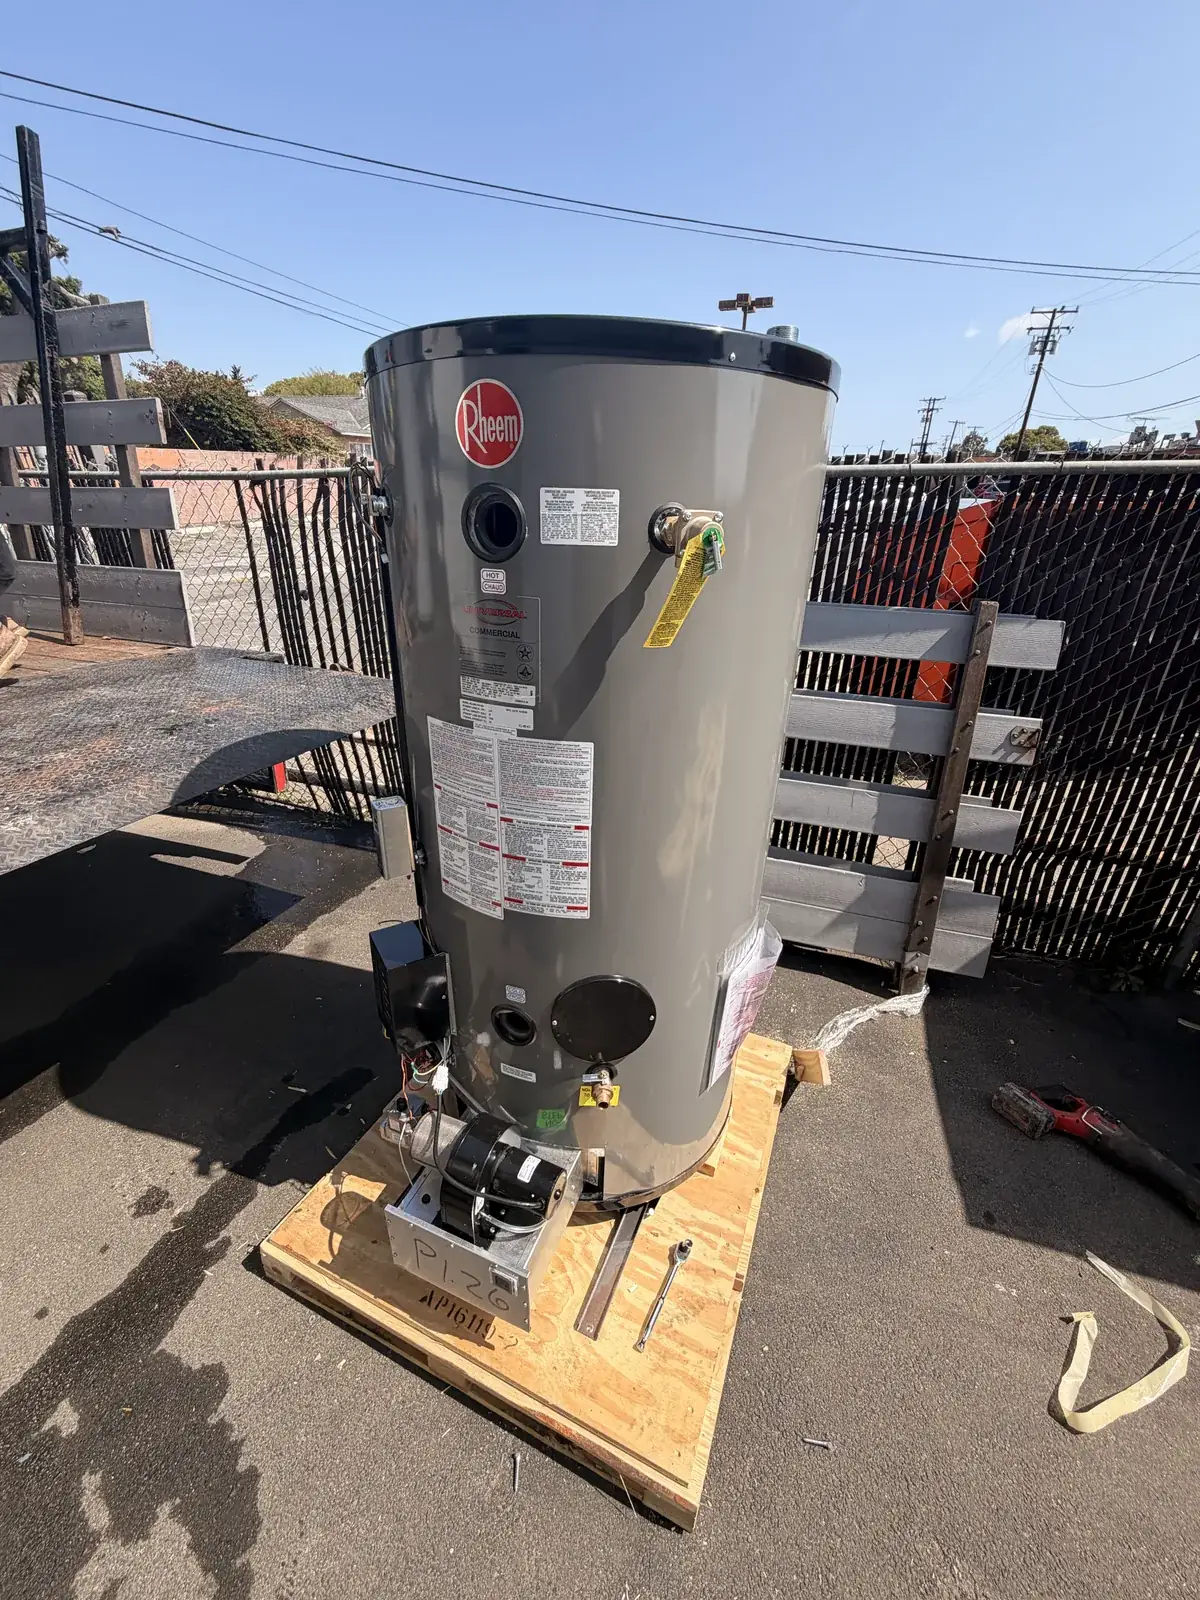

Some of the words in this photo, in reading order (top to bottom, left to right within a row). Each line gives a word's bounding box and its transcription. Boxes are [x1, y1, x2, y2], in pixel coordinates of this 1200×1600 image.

[462, 384, 518, 454] Rheem
[484, 583, 504, 591] CHAUD
[469, 626, 520, 639] COMMERCIAL
